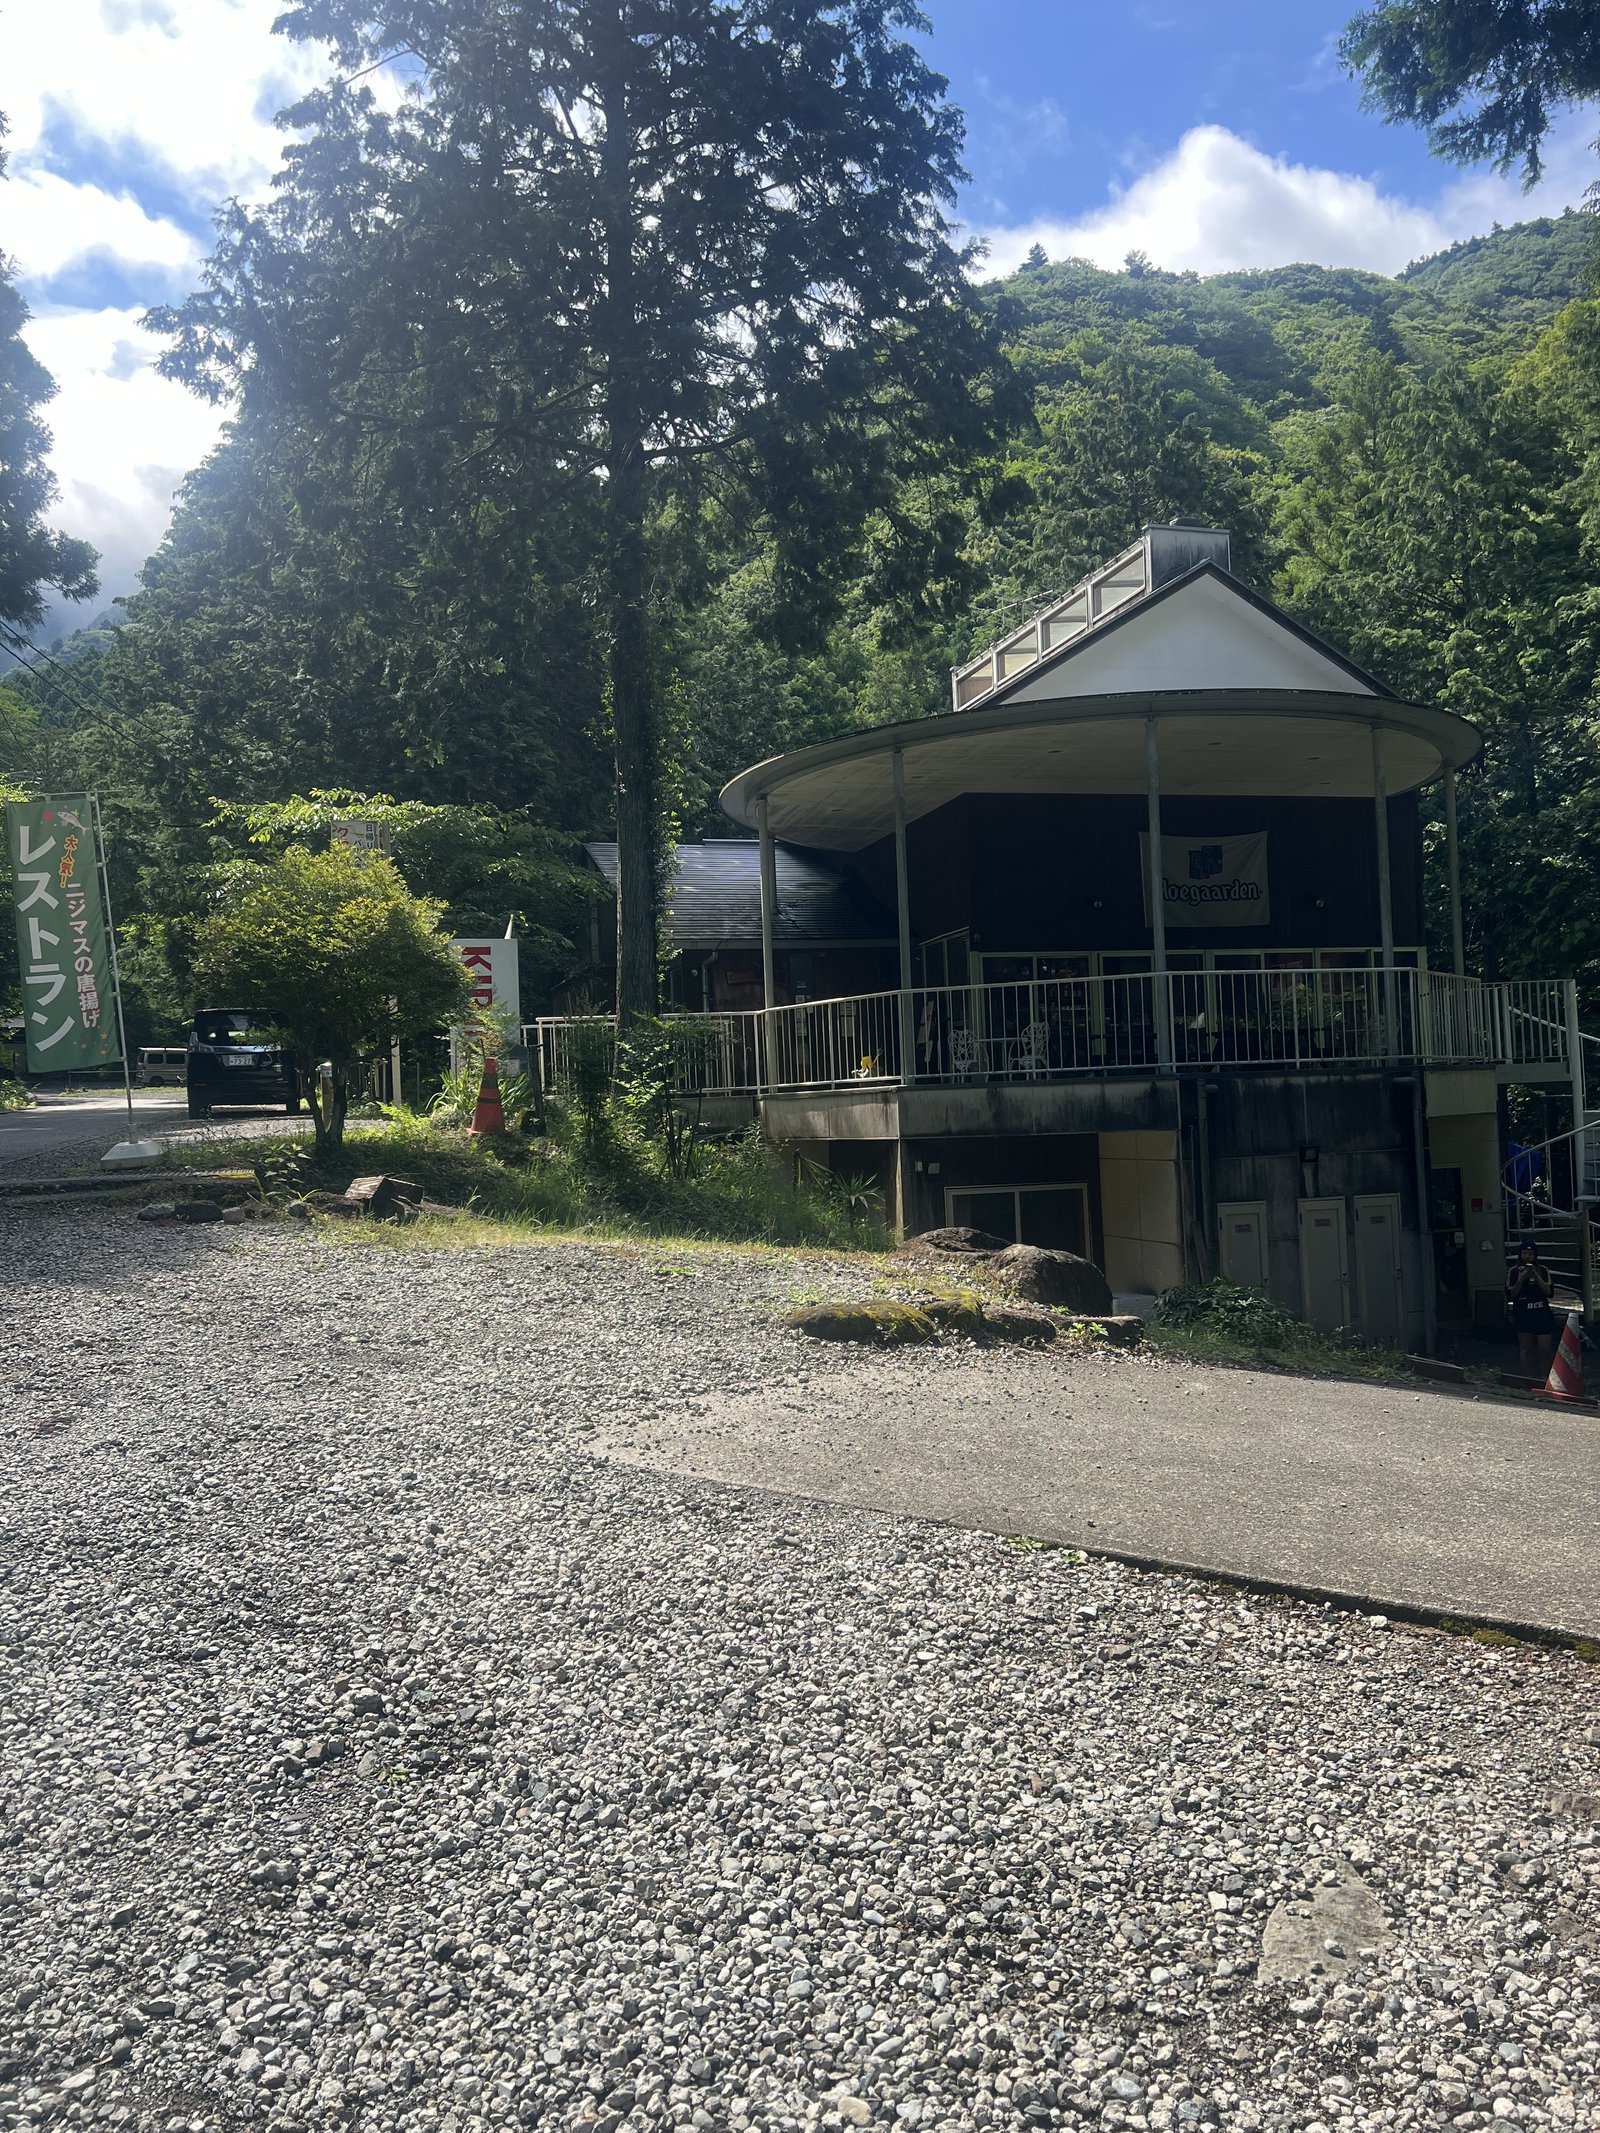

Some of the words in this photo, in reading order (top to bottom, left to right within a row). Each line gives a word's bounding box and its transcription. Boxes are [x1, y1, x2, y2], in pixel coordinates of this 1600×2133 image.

[17, 825, 75, 1052] レストラン
[65, 882, 100, 1029] ニジマスの唐揚げ
[1161, 877, 1260, 907] oegaarden
